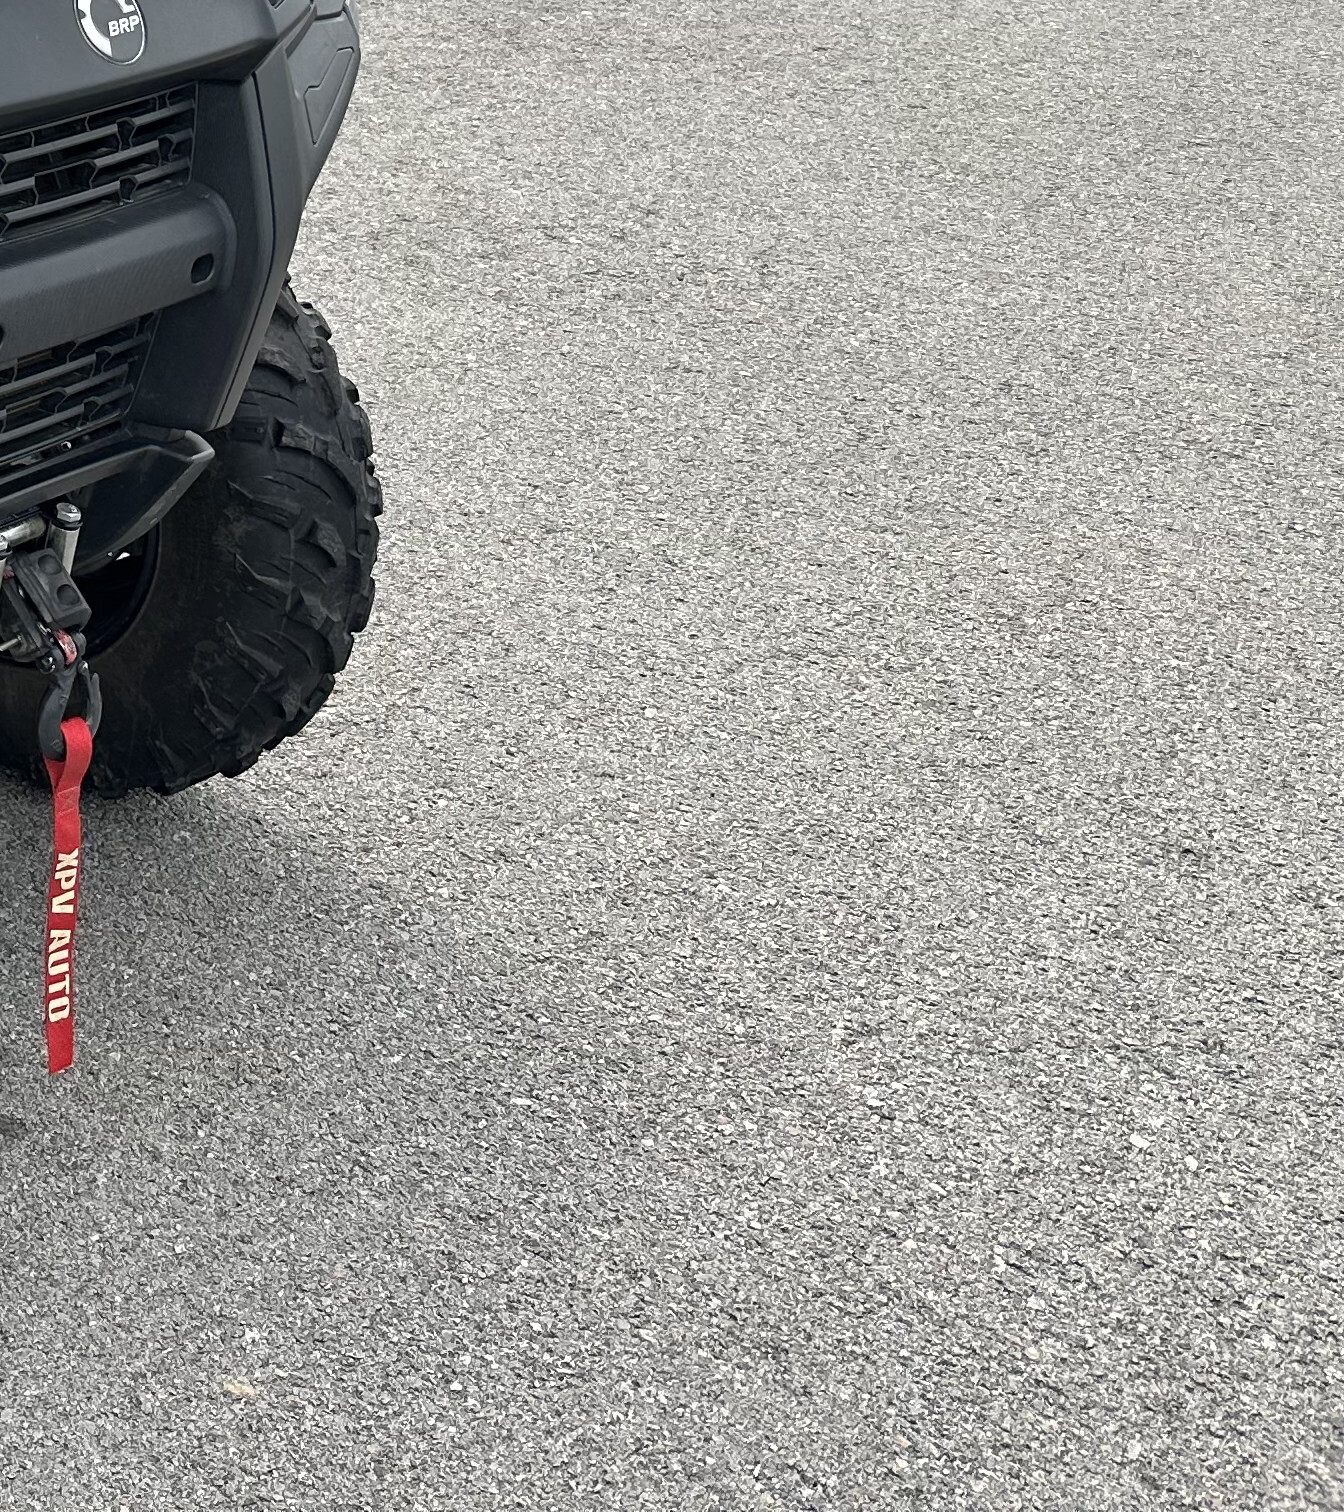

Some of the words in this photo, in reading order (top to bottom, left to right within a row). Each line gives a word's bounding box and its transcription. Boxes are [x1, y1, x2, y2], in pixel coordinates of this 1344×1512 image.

[108, 14, 140, 37] BRP
[50, 847, 80, 915] XPV
[48, 928, 72, 1024] AUTO
